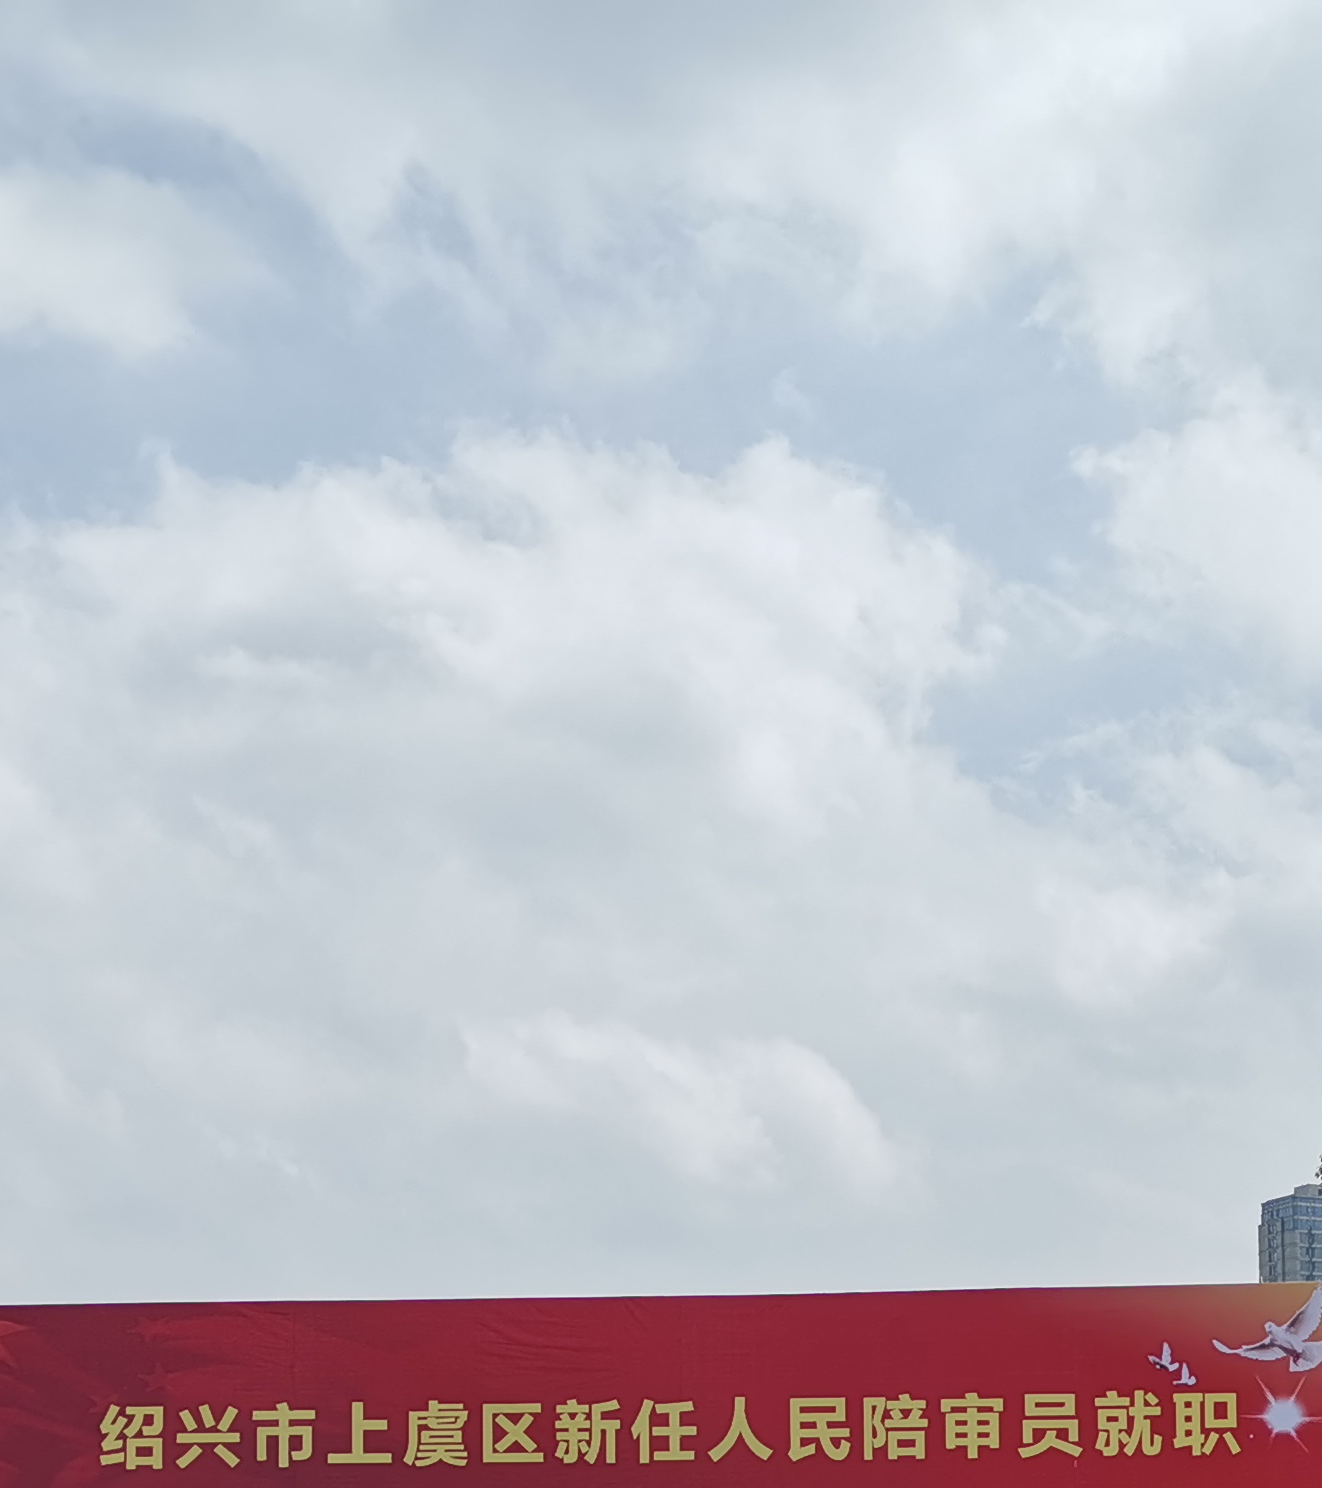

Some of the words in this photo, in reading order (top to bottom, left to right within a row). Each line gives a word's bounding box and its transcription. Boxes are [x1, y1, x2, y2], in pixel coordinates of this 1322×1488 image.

[99, 1389, 1241, 1470] 绍兴市上虞区新任人民陪审员就职
